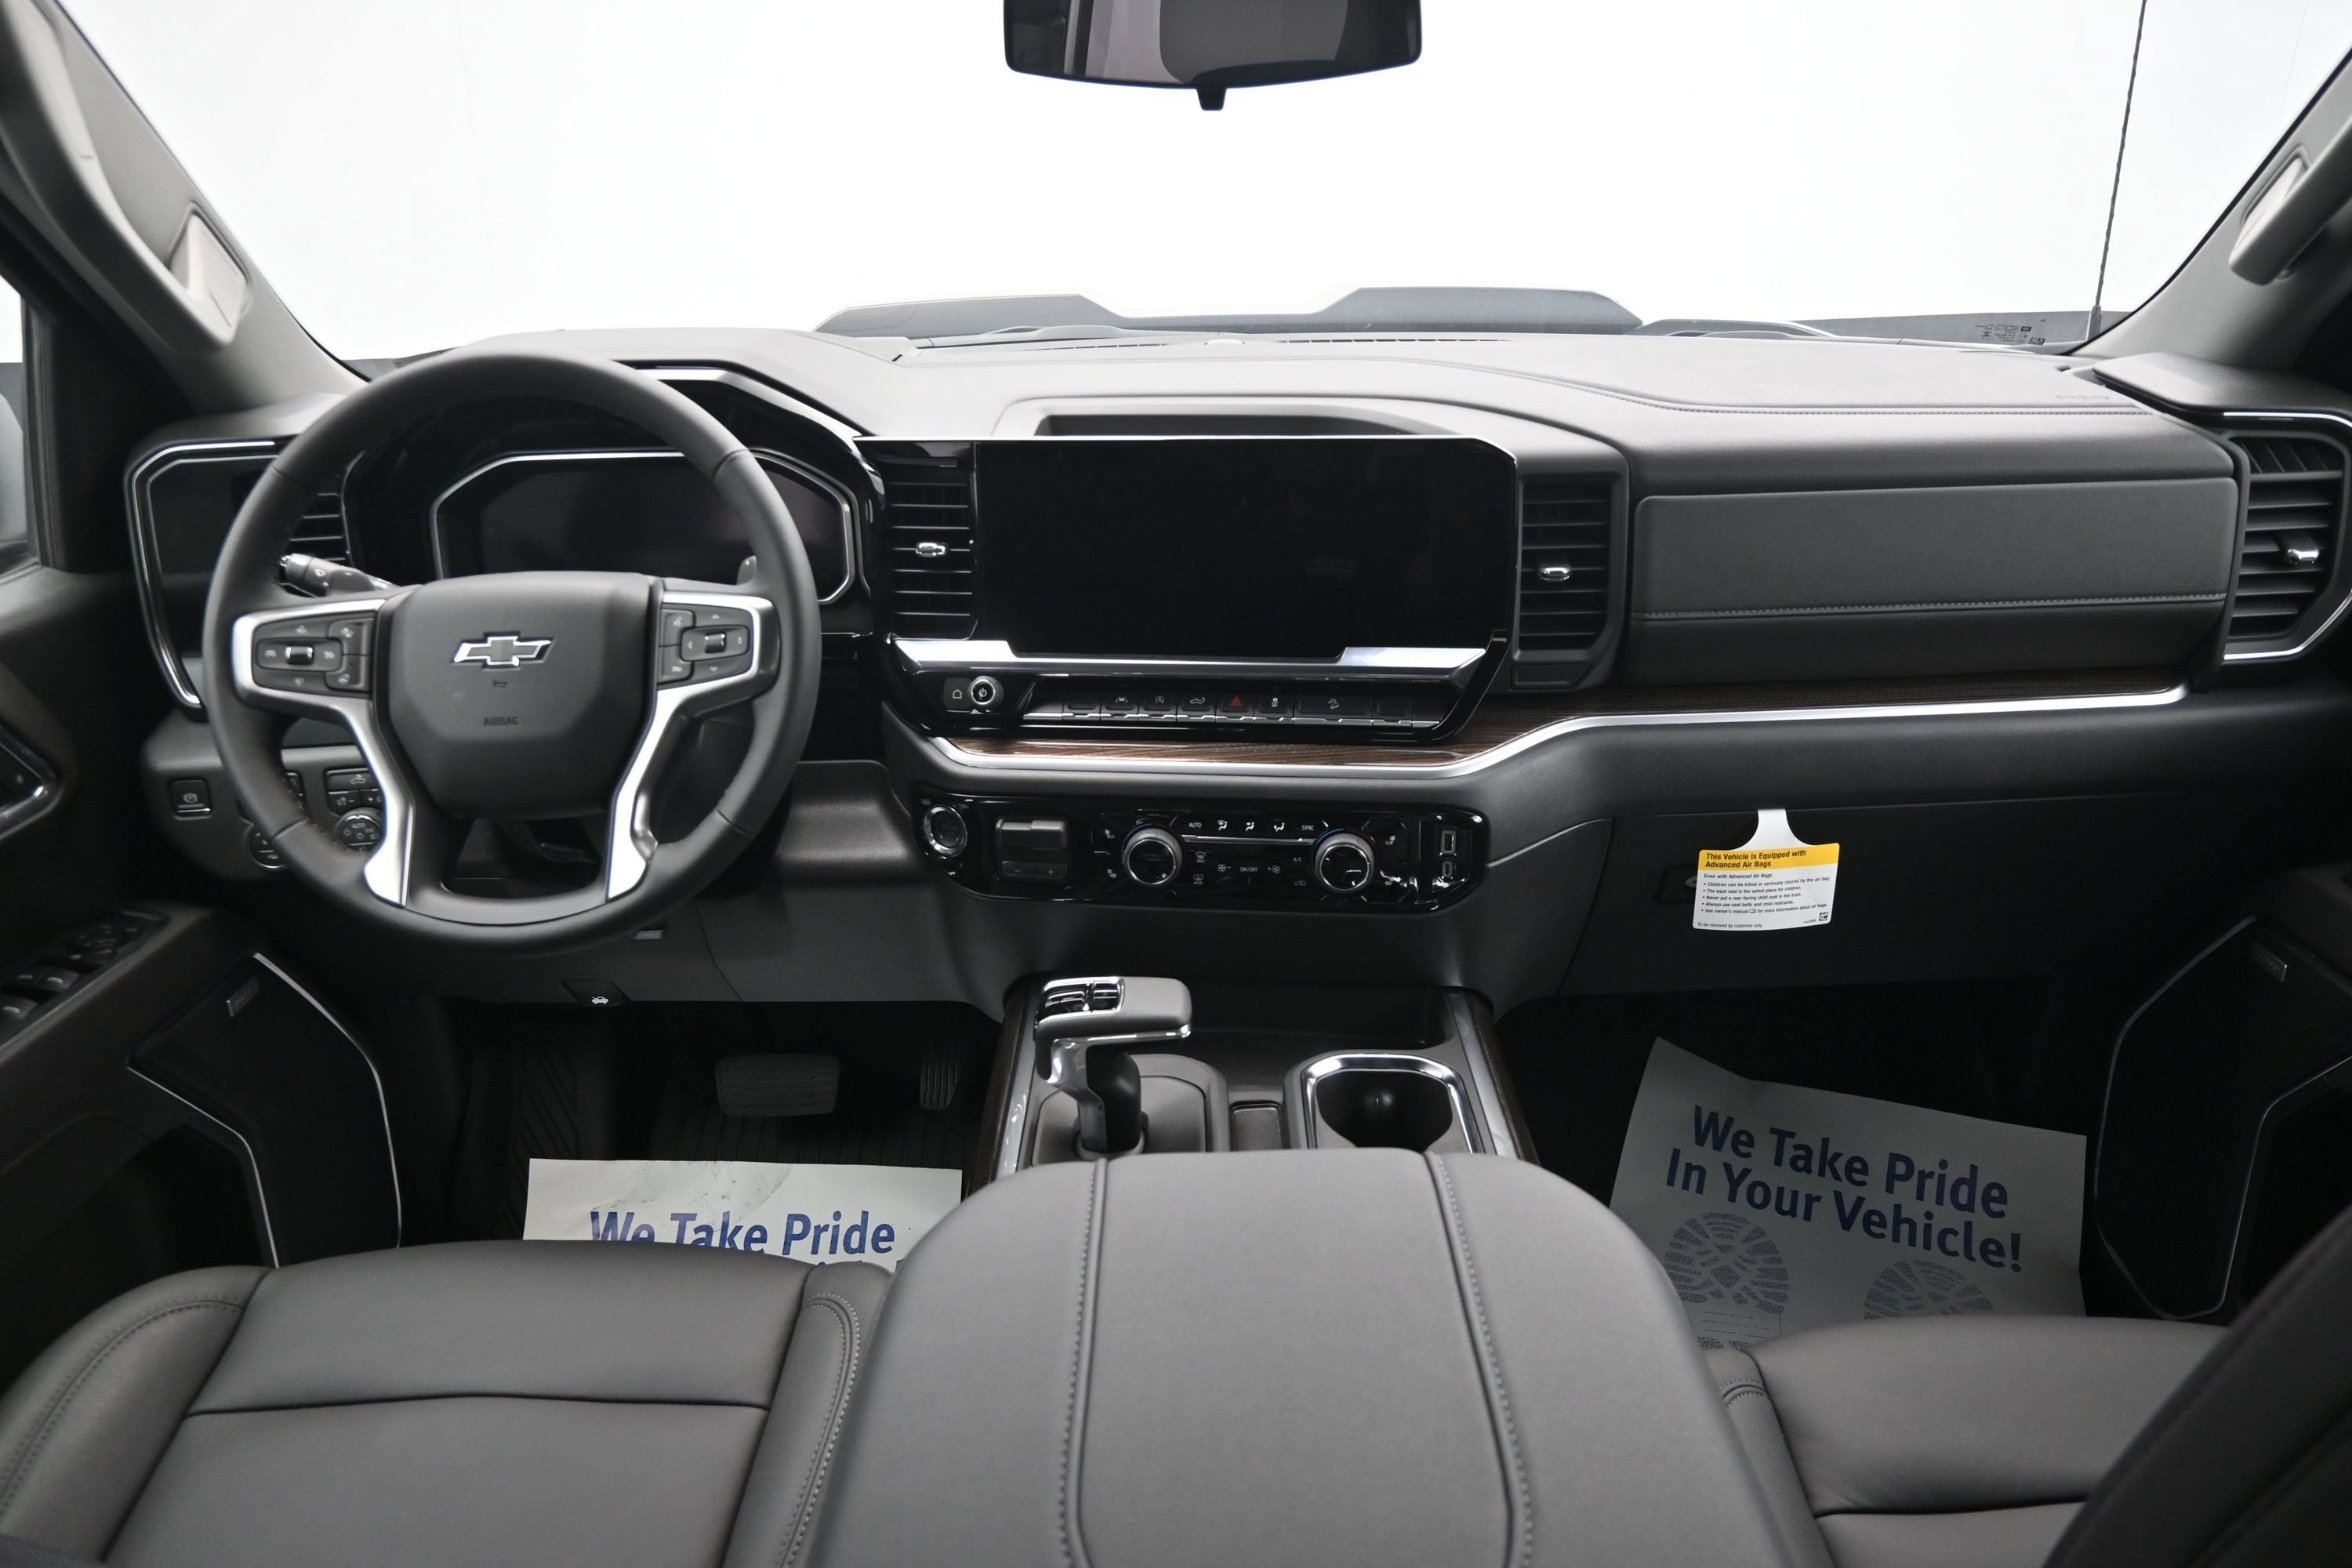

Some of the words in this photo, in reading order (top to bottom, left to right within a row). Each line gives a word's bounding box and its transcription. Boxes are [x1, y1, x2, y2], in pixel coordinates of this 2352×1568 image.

[1759, 851, 1790, 860] Equipped
[1694, 1105, 1755, 1158] We
[1769, 1127, 1869, 1187] Take
[1884, 1152, 2008, 1219] Pride
[590, 1211, 655, 1242] We
[670, 1211, 768, 1254] Take
[782, 1210, 895, 1256] Pride
[1666, 1147, 1707, 1195] In
[1723, 1162, 1821, 1222] Your
[1833, 1190, 2022, 1273] Vehicle!
